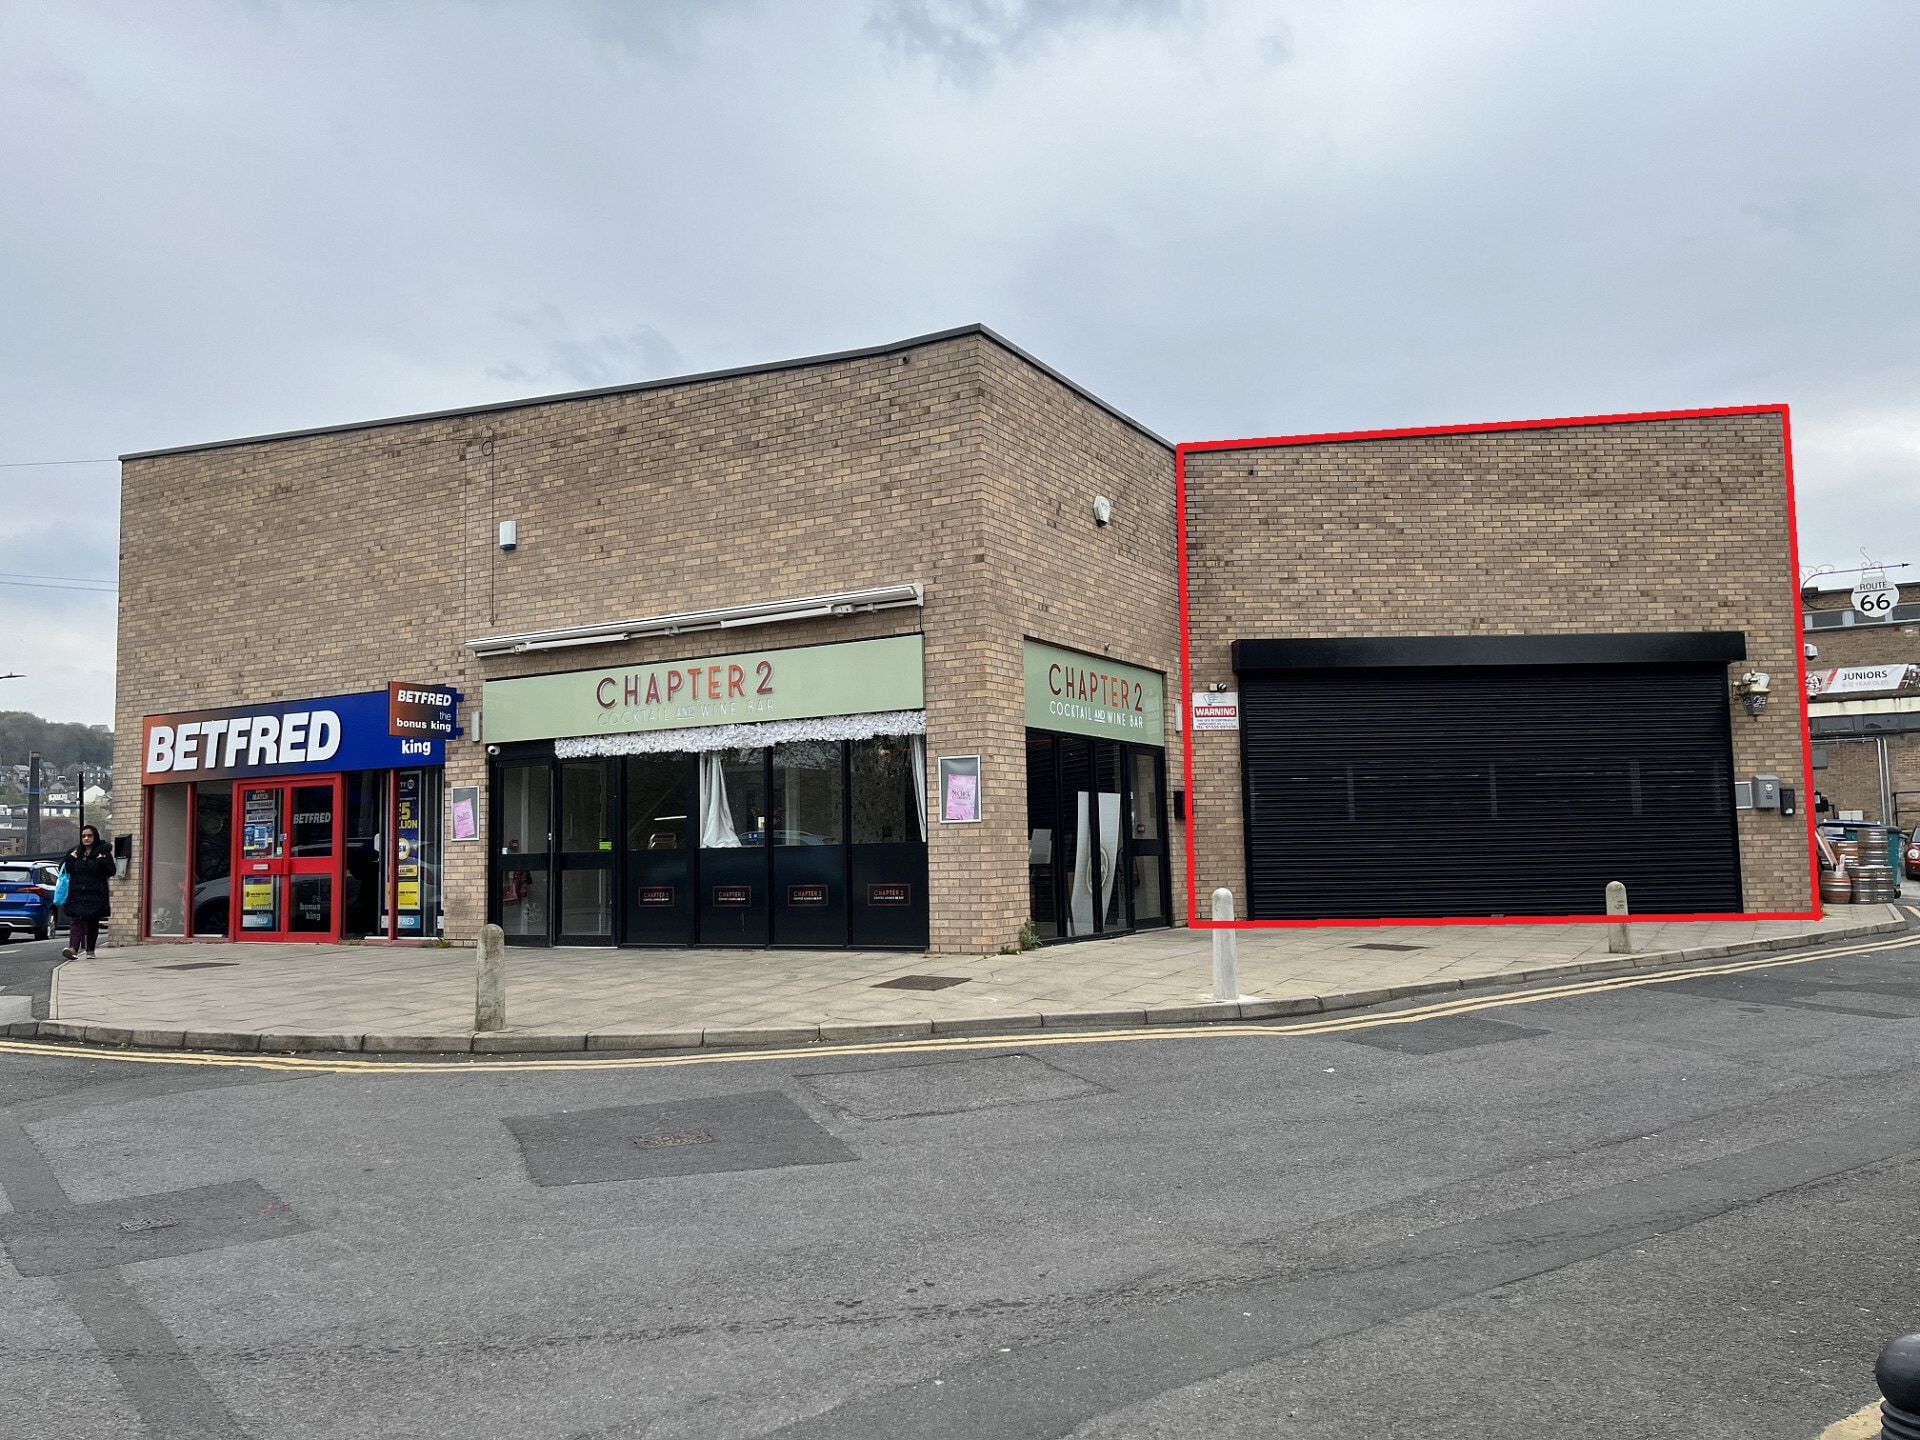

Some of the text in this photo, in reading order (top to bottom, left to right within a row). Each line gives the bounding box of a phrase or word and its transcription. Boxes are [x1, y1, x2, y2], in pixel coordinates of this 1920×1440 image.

[1860, 581, 1888, 591] ROUTE
[1860, 593, 1891, 612] 66
[1842, 670, 1888, 681] JUNIORS
[596, 660, 774, 710] CHAPTER 2
[1048, 663, 1143, 712] CHAPTER 2
[397, 689, 452, 707] BETFRED
[439, 711, 452, 721] the
[597, 699, 775, 727] COCKTAIL AND WINE BAR
[1049, 700, 1144, 729] COCKTAIL AND WINE BAR
[1195, 706, 1236, 717] WARNING
[396, 717, 452, 733] bonus king
[146, 710, 342, 774] BETFRED
[401, 738, 432, 756] king
[293, 812, 332, 825] BETFRED
[299, 902, 321, 911] bonus
[305, 911, 321, 921] king
